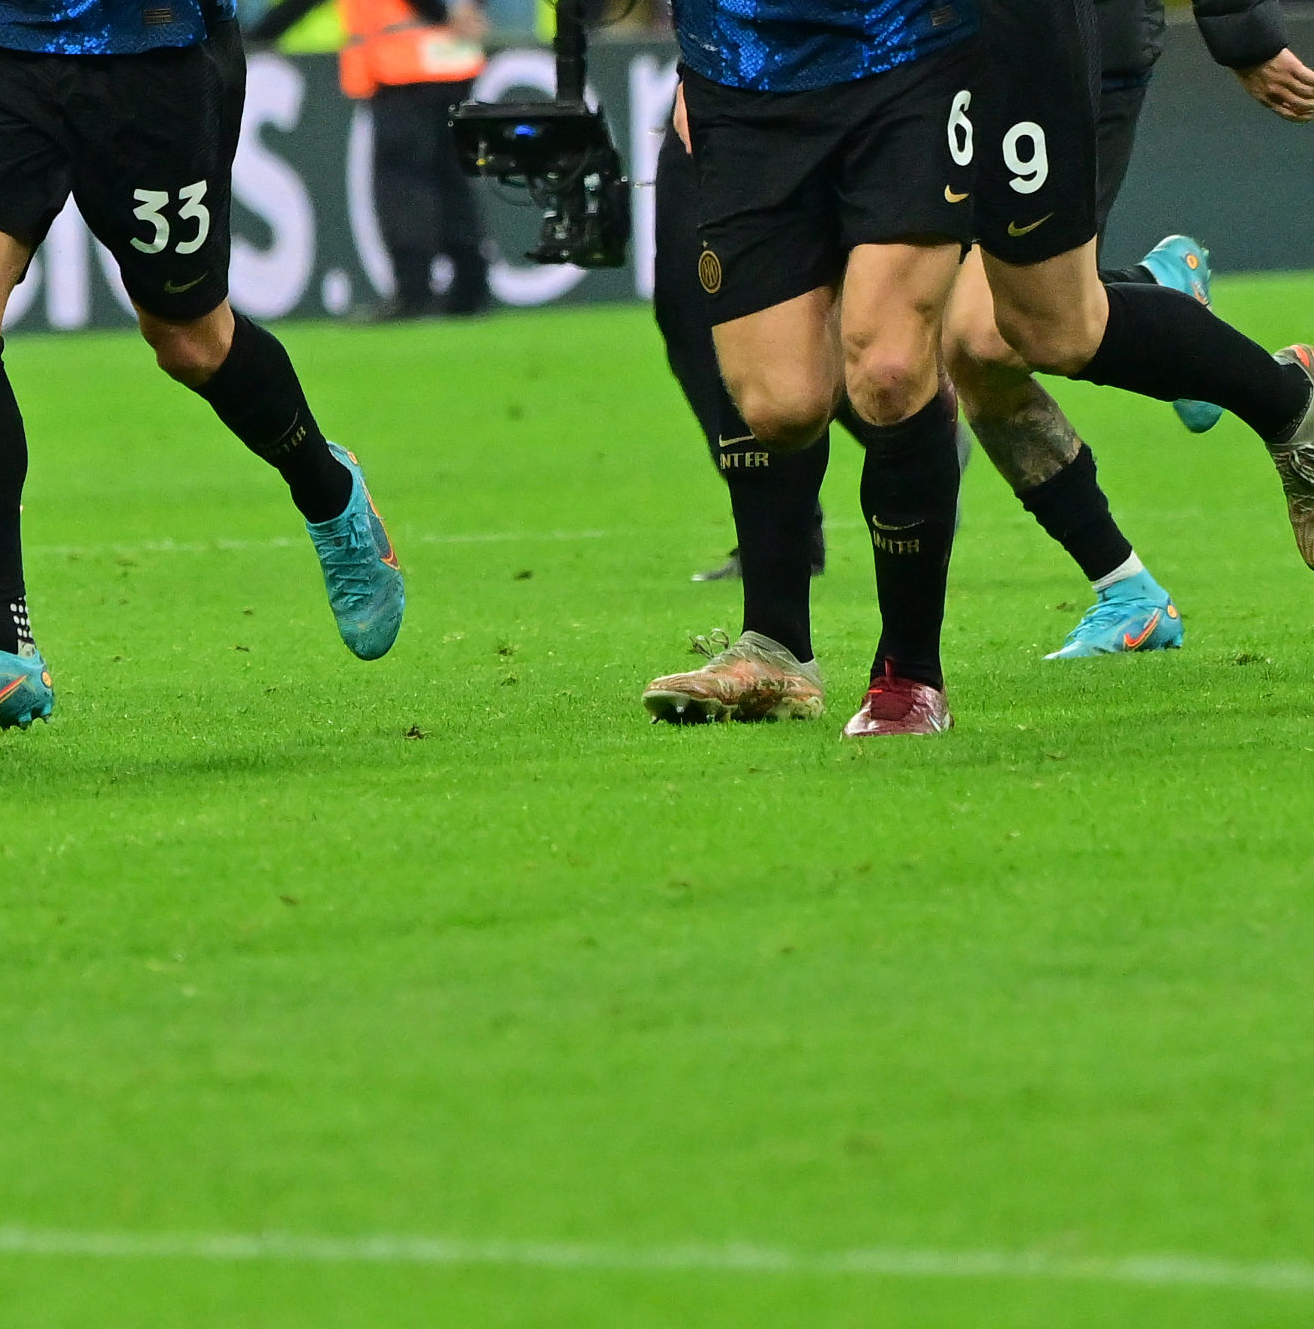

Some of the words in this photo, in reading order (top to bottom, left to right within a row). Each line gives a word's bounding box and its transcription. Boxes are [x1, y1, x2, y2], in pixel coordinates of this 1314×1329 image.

[946, 89, 973, 168] 6
[1001, 120, 1050, 195] 9
[130, 179, 212, 255] 33
